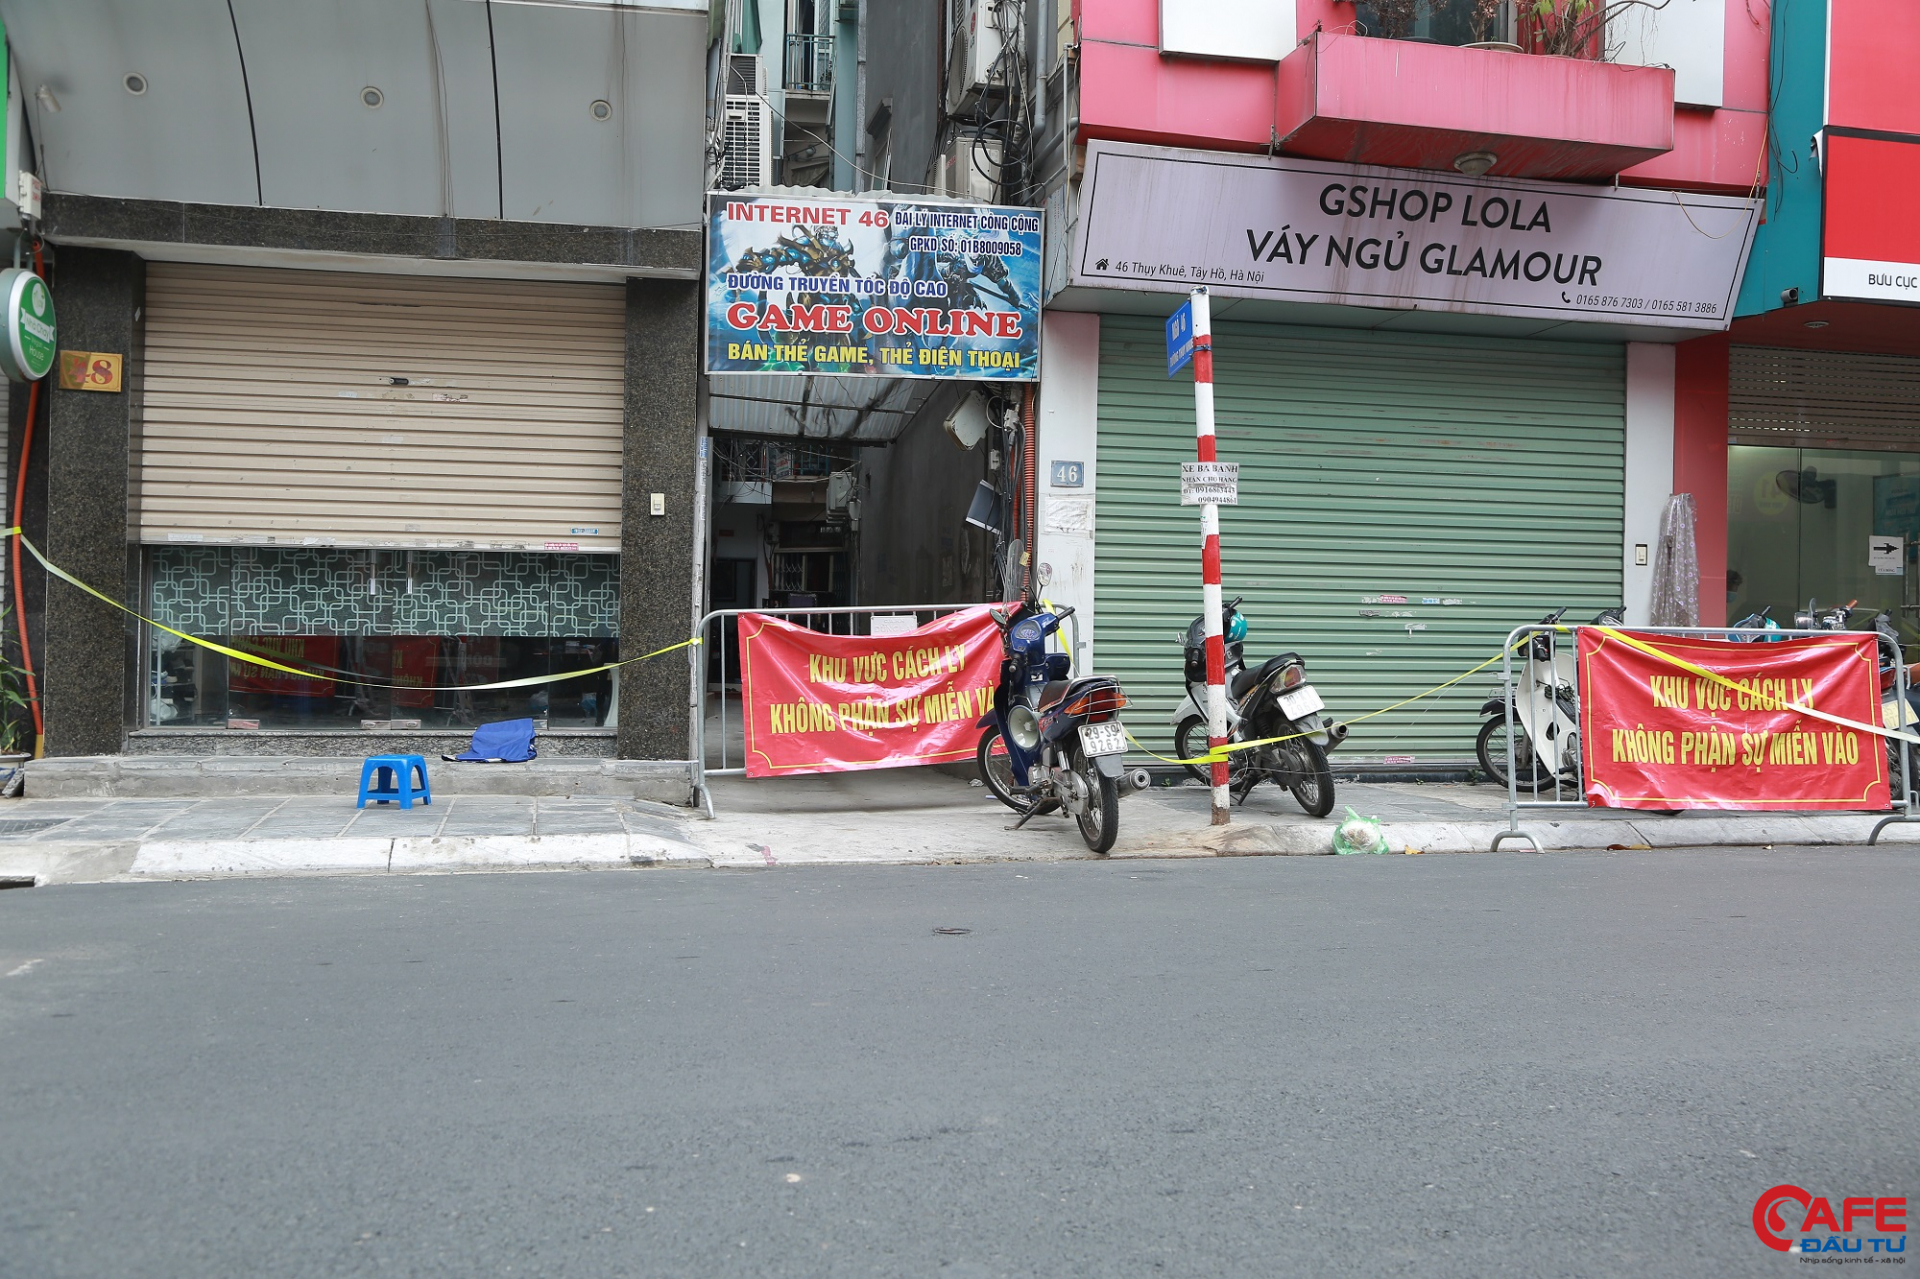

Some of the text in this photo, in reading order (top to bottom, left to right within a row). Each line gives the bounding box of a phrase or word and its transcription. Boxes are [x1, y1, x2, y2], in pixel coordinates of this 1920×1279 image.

[727, 202, 889, 228] INTERNET 46
[1319, 183, 1551, 232] GSHOP LOLA
[896, 208, 1038, 235] ĐẠI LÝ INTERNET CÔNG CỘNG
[910, 232, 1022, 256] GPKD SỐ: 01B8009058
[1246, 224, 1602, 286] VÁY NGỦ GLAMOUR
[728, 272, 948, 298] ĐƯỜNG TRUYỀN TỐC ĐỘ CAO
[1115, 261, 1265, 284] 46 Thụy Khuê, Tây Hồ, Hà Nội
[1868, 274, 1918, 290] BƯU CỤC
[1576, 294, 1600, 307] 0165
[1601, 296, 1619, 308] 876
[1621, 296, 1643, 310] 7303
[1652, 299, 1674, 312] 0165
[1676, 300, 1692, 312] 581
[1694, 301, 1718, 314] 3886
[727, 303, 1022, 338] GAME ONLINE
[728, 338, 1020, 372] BÁN THẺ GAME, THẺ ĐIỆN THOẠI
[69, 358, 114, 385] 48
[1056, 466, 1078, 482] 46
[1182, 464, 1194, 472] XE
[1198, 464, 1210, 472] BA
[809, 644, 966, 688] KHU VỰC CÁCH LY
[770, 680, 996, 736] KHÔNG PHẬN SỰ MIỄN VÀ
[1650, 673, 1814, 718] KHU VỰC CÁCH LY
[1612, 720, 1859, 773] KHÔNG PHẬN SỰ MIỄN VÀO
